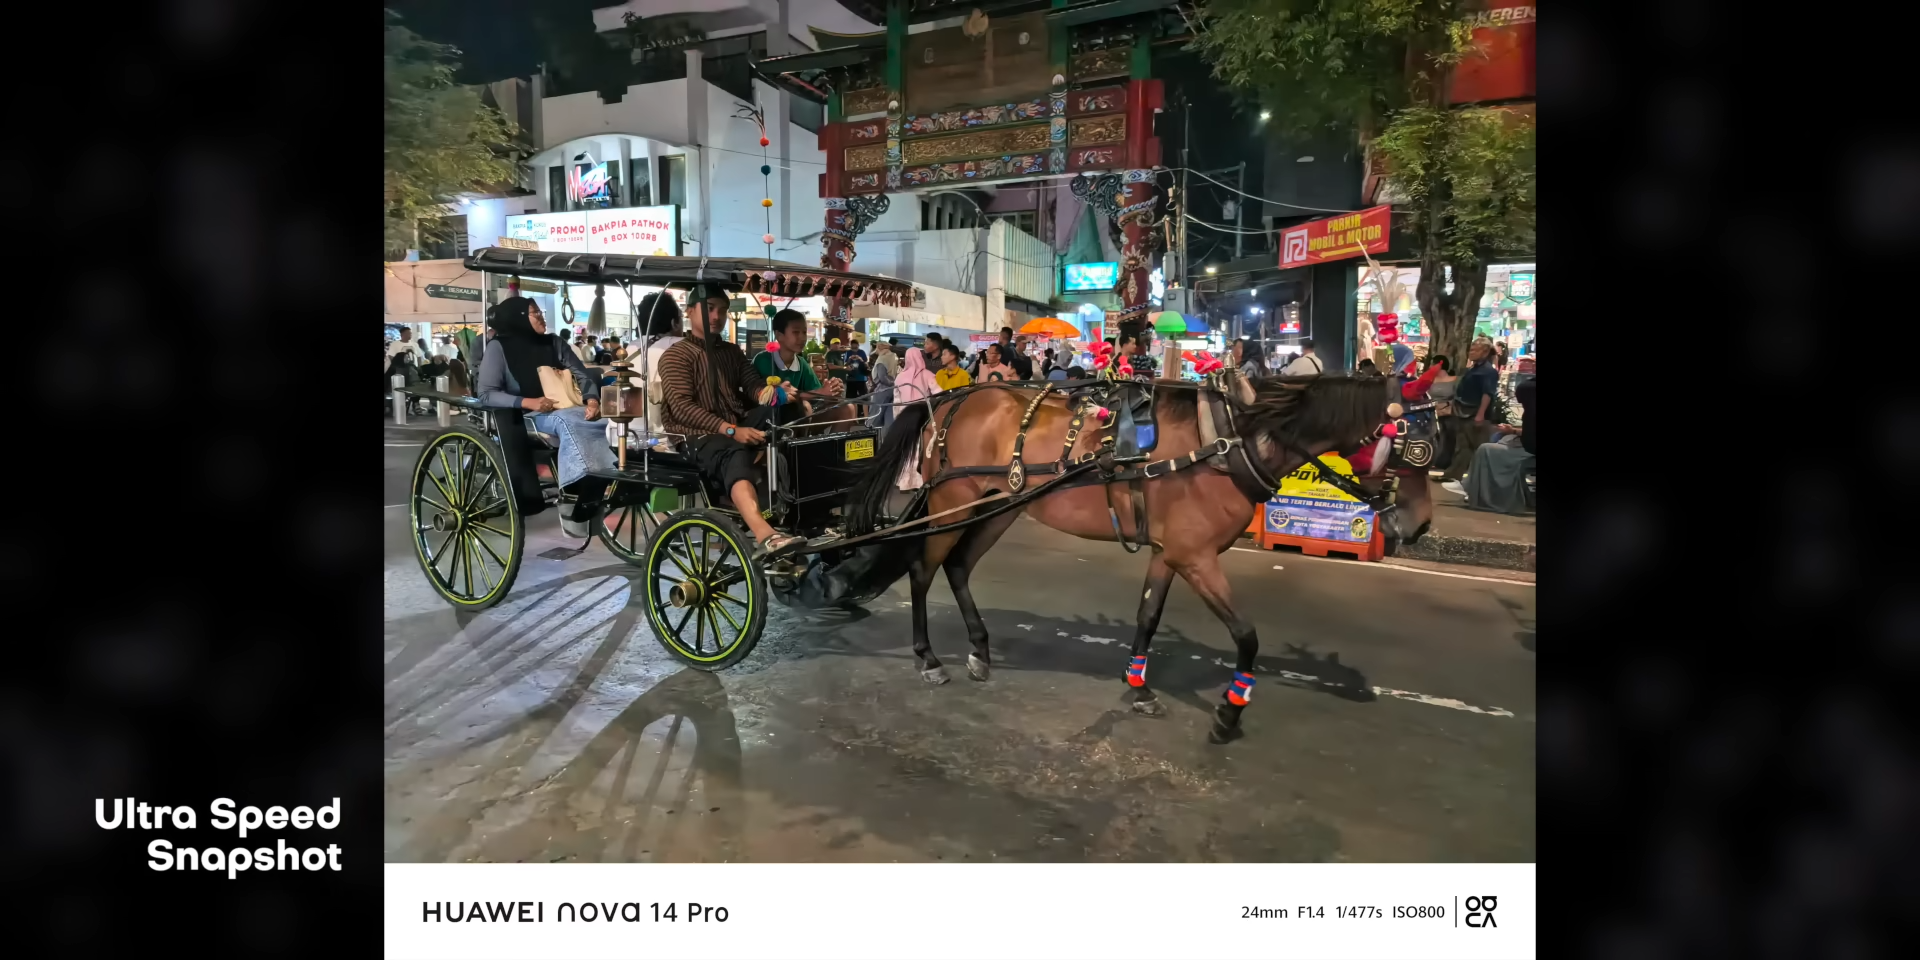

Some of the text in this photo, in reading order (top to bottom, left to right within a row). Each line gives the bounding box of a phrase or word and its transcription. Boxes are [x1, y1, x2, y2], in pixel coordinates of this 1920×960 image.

[550, 225, 585, 235] PROMO
[591, 219, 669, 235] BAKPIA PATHOK
[1327, 214, 1361, 233] PARKIR
[611, 232, 627, 242] BOX
[631, 232, 657, 242] 100RB
[1309, 224, 1382, 251] MOBIL & MOTOR
[1314, 500, 1344, 508] BERLALU
